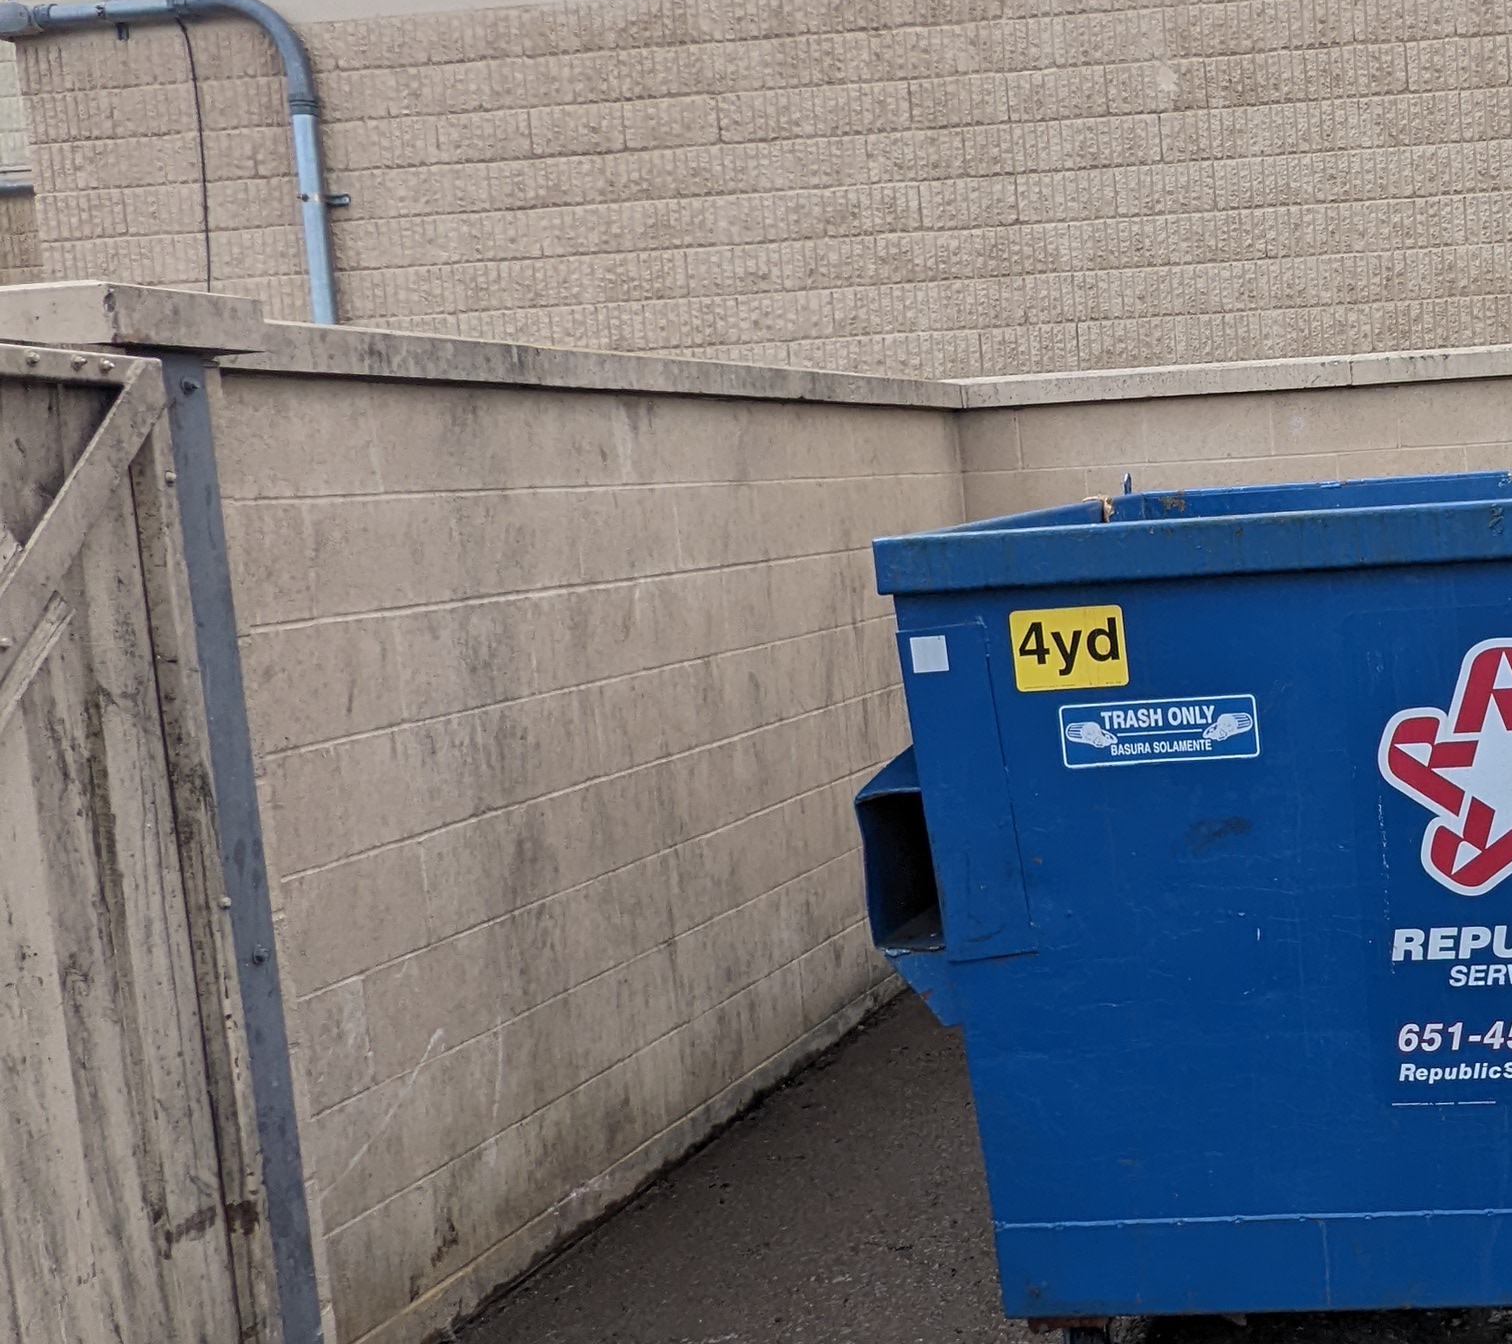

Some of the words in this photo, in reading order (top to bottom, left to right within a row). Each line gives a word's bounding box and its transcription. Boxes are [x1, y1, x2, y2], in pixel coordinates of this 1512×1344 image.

[1018, 617, 1121, 676] 4yd
[1101, 708, 1163, 730] TRASH
[1167, 705, 1215, 726] ONLY
[1110, 740, 1152, 756] BASURA
[1153, 739, 1213, 754] SOLAMENTE
